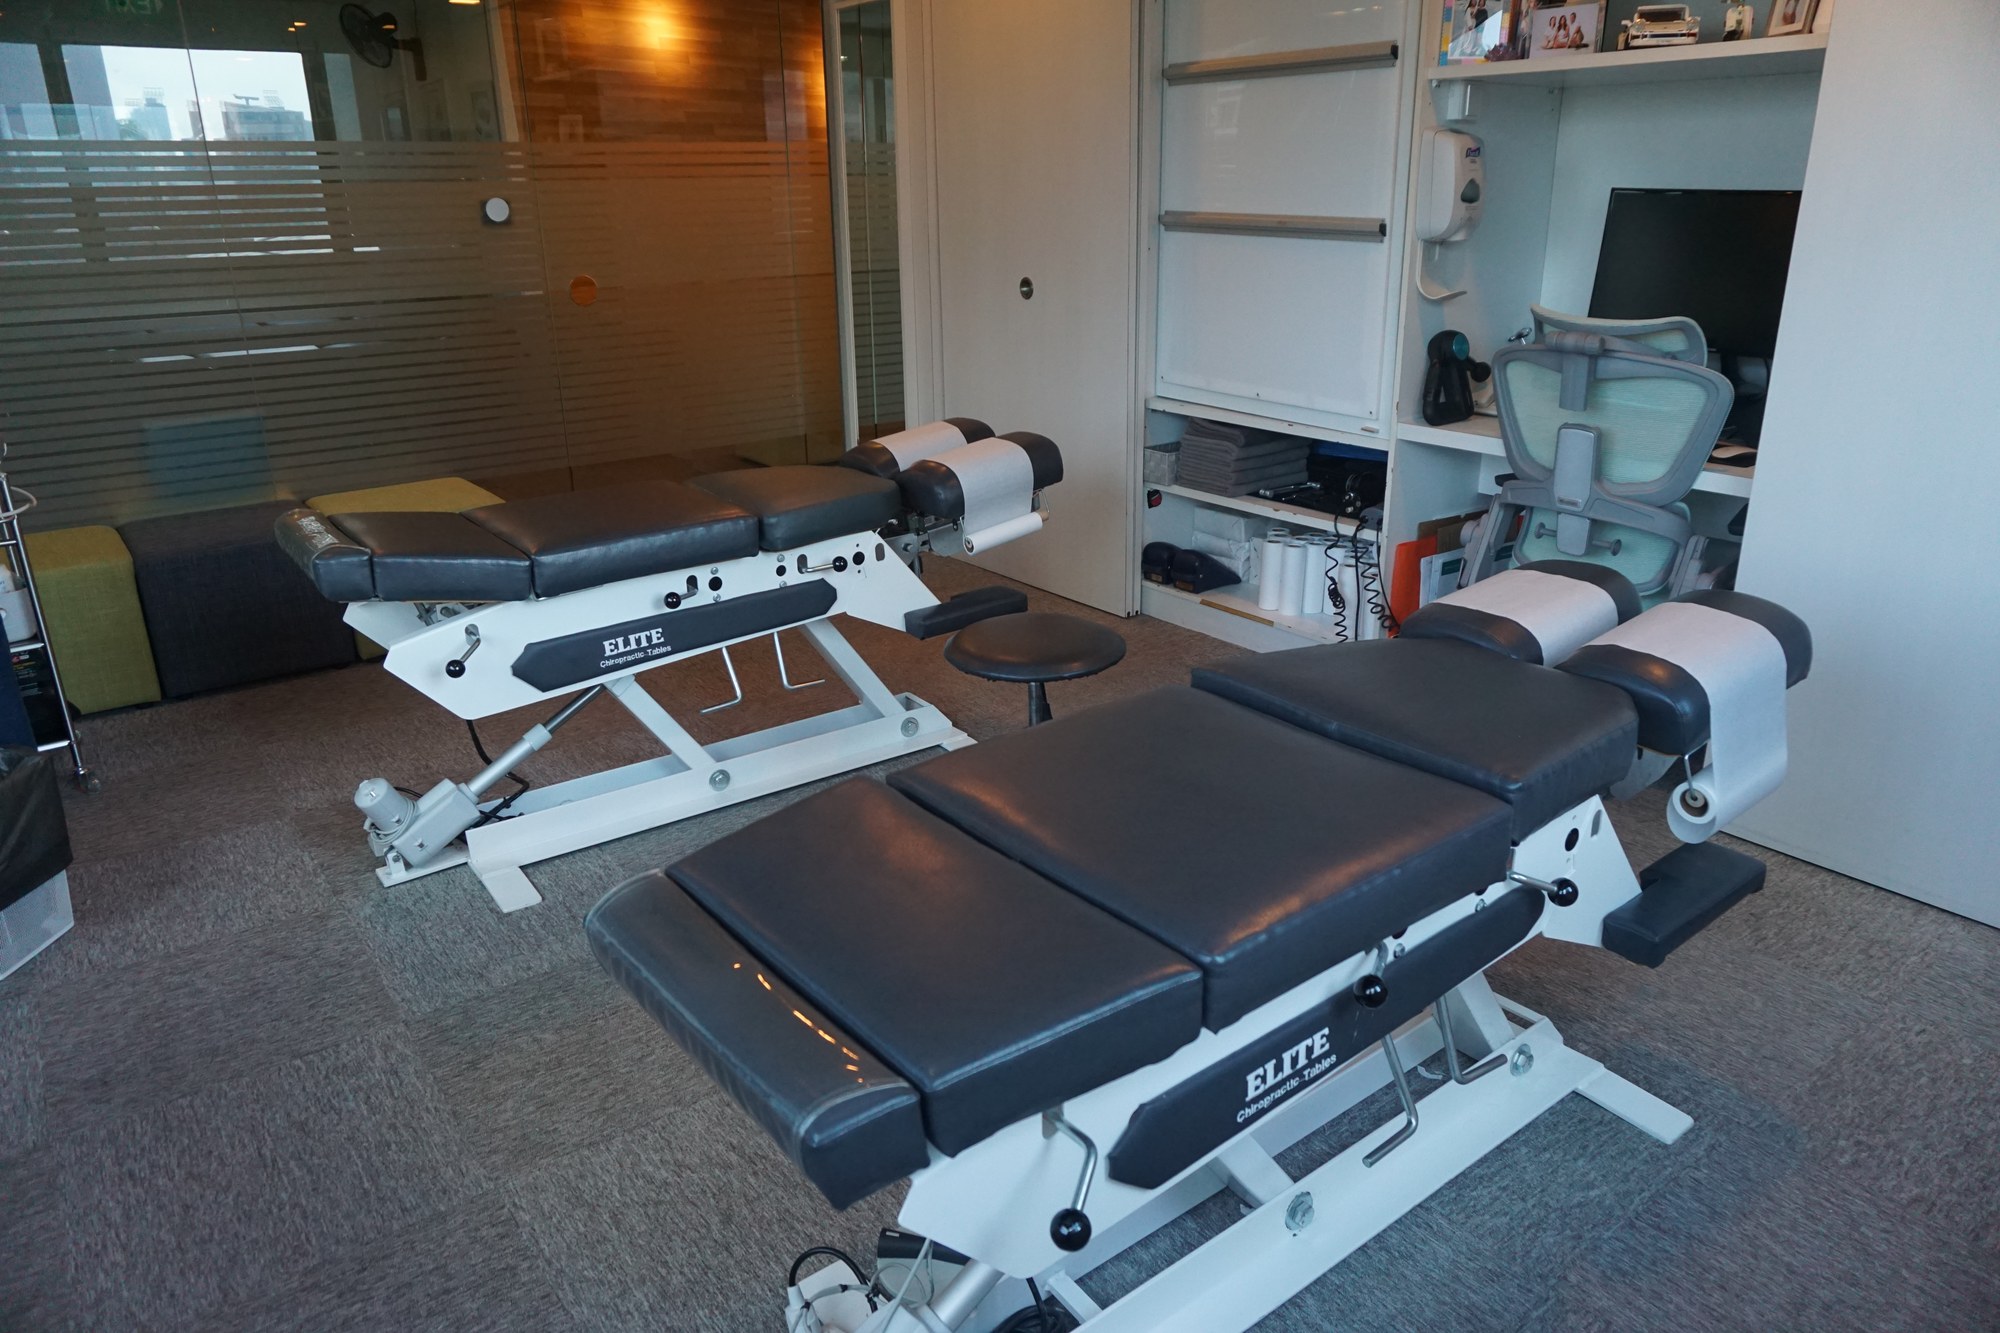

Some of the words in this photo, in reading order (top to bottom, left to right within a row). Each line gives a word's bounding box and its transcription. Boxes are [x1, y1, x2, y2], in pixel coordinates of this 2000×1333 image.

[599, 651, 645, 668] Chiropractic
[646, 645, 672, 656] Tables
[602, 627, 665, 657] ELITE
[1236, 1076, 1300, 1123] Chiropractic
[1302, 1054, 1337, 1082] Tables
[1245, 1026, 1330, 1102] ELITE
